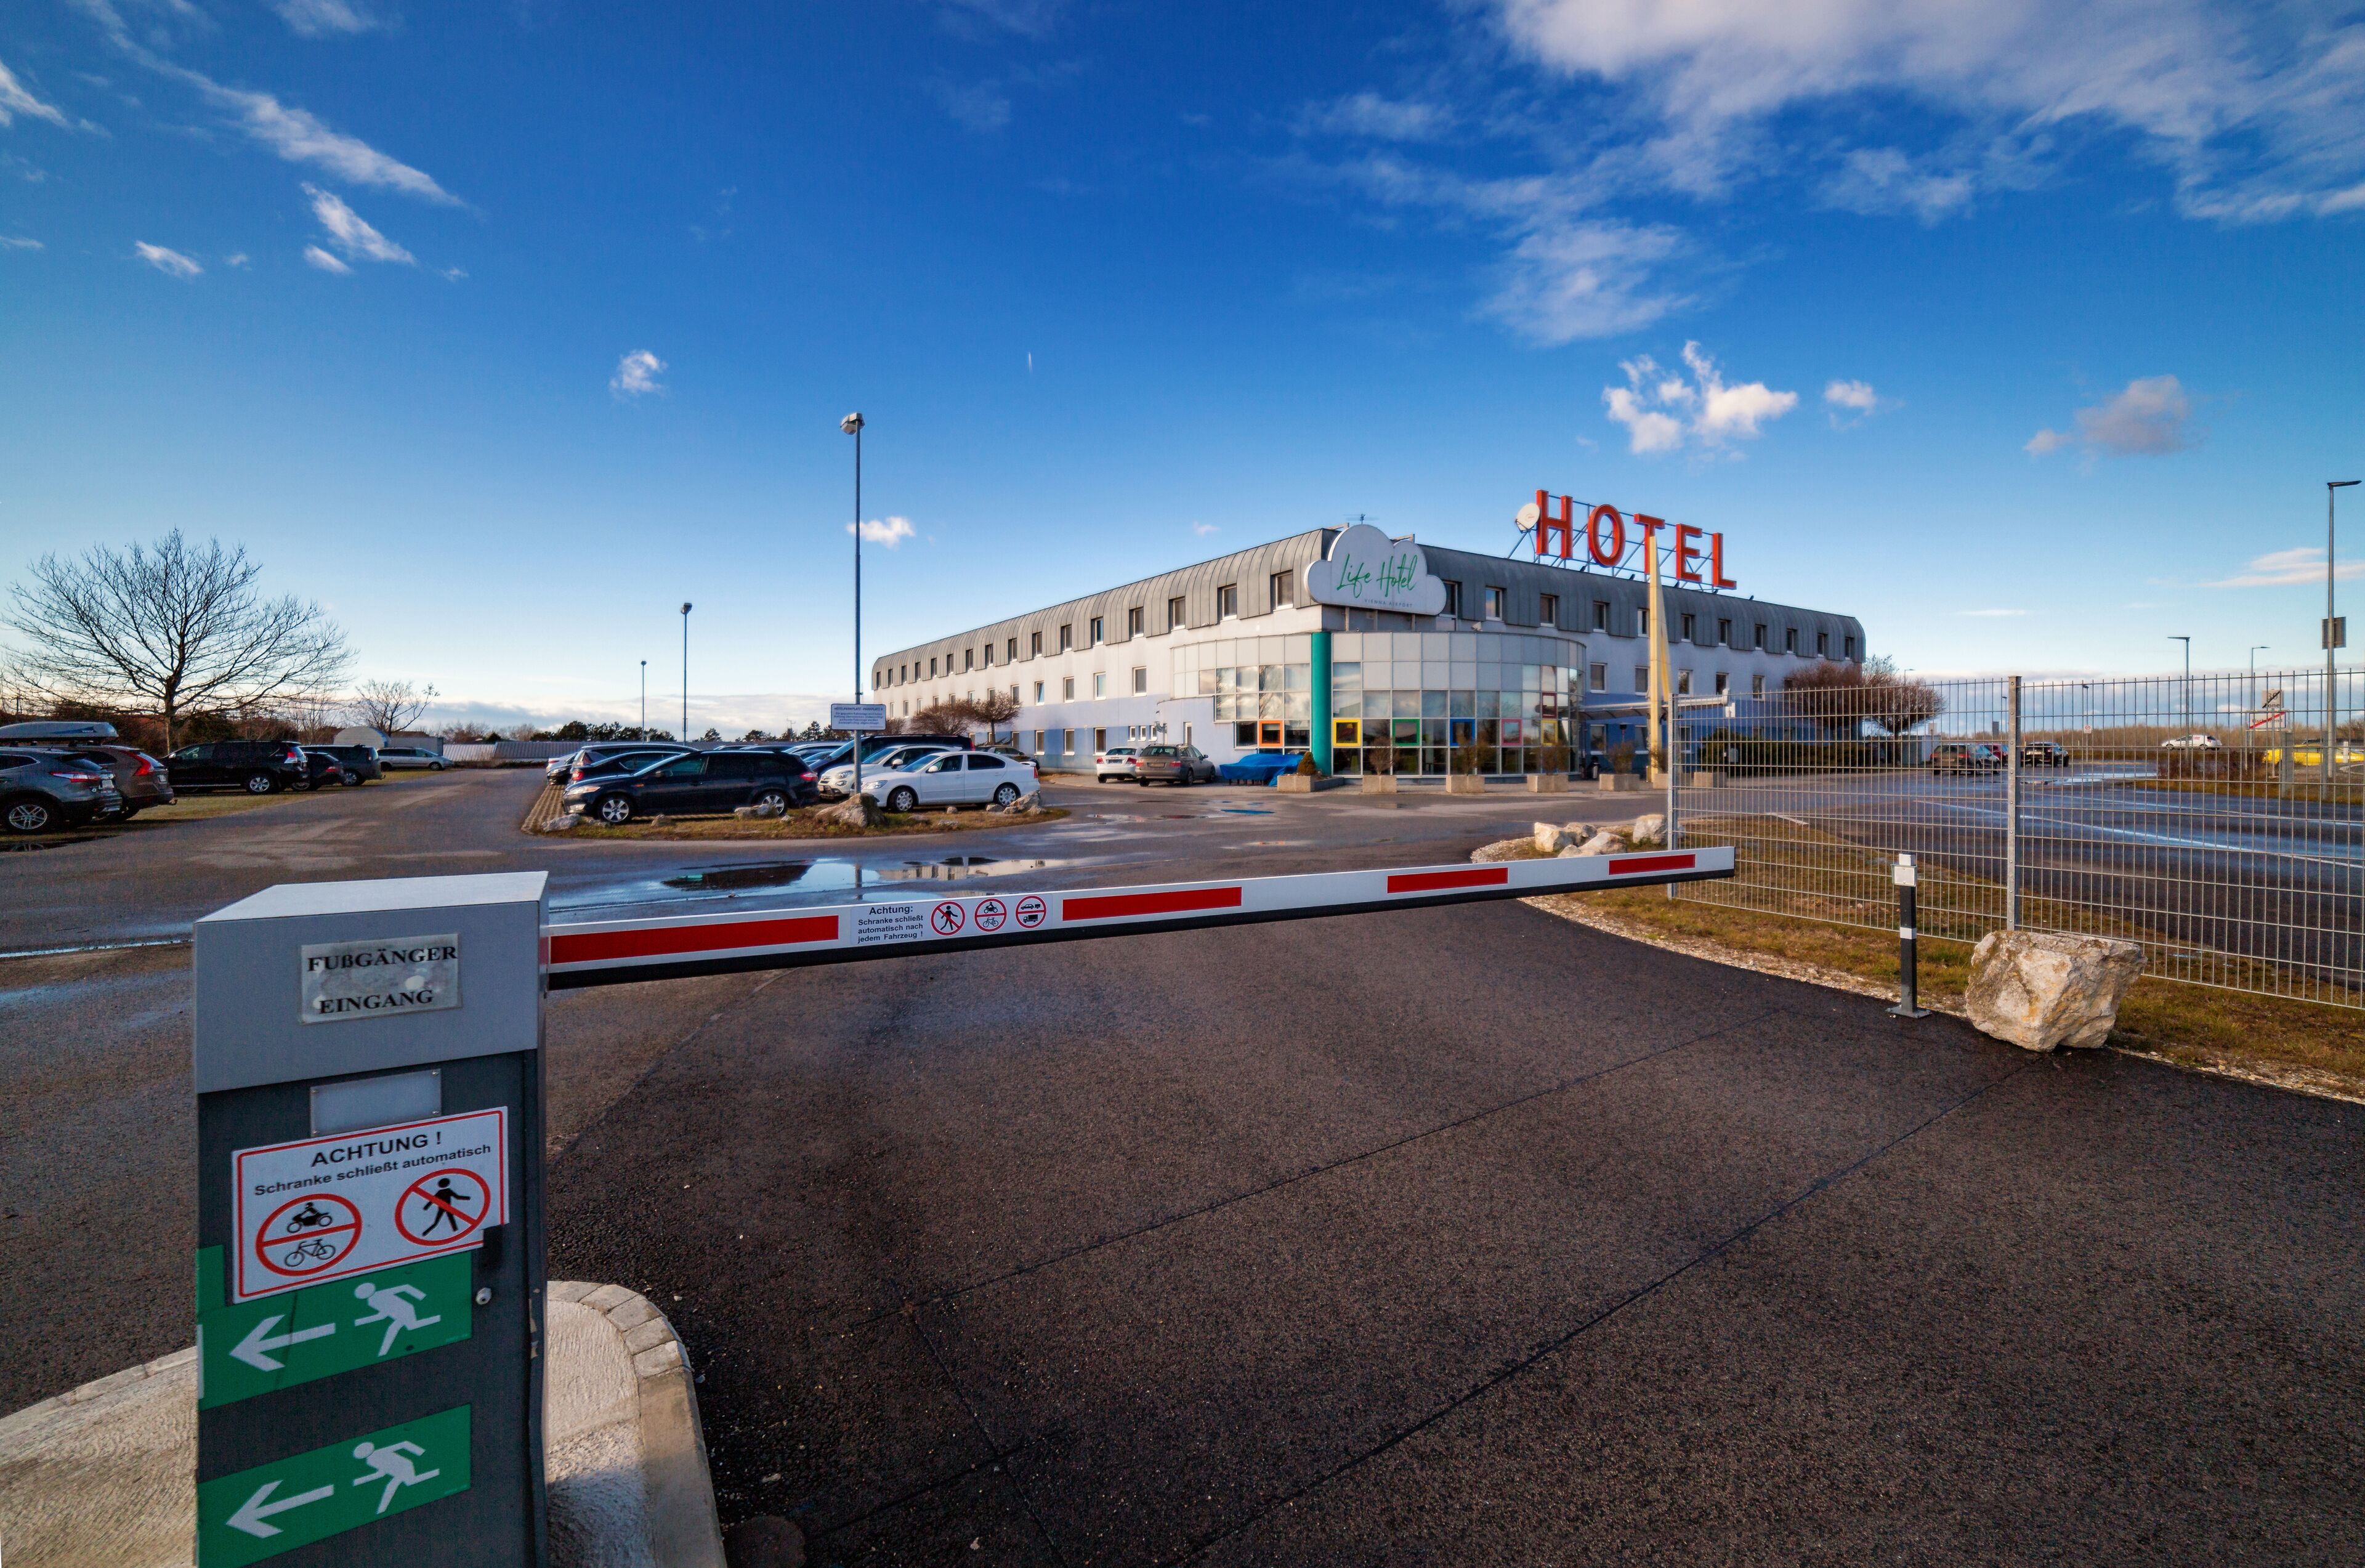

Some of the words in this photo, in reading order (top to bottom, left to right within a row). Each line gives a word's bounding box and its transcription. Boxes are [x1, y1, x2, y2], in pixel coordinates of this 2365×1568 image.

[1535, 489, 1737, 590] HOTEL
[1336, 553, 1373, 598] Life
[1376, 553, 1418, 597] Hotel
[858, 918, 893, 926] Schranke
[895, 915, 923, 923] schließt
[869, 905, 913, 915] Achtung:
[857, 935, 881, 944] jedem
[884, 932, 918, 940] Fahrzeug
[858, 925, 904, 934] automatisch
[308, 946, 458, 971] FUßGÄNGER
[319, 989, 434, 1014] EINGANG
[311, 1133, 428, 1167] ACHTUNG
[436, 1131, 442, 1144] !
[254, 1174, 331, 1196] Schranke
[337, 1161, 398, 1180] schließt
[402, 1144, 491, 1168] automatisch
